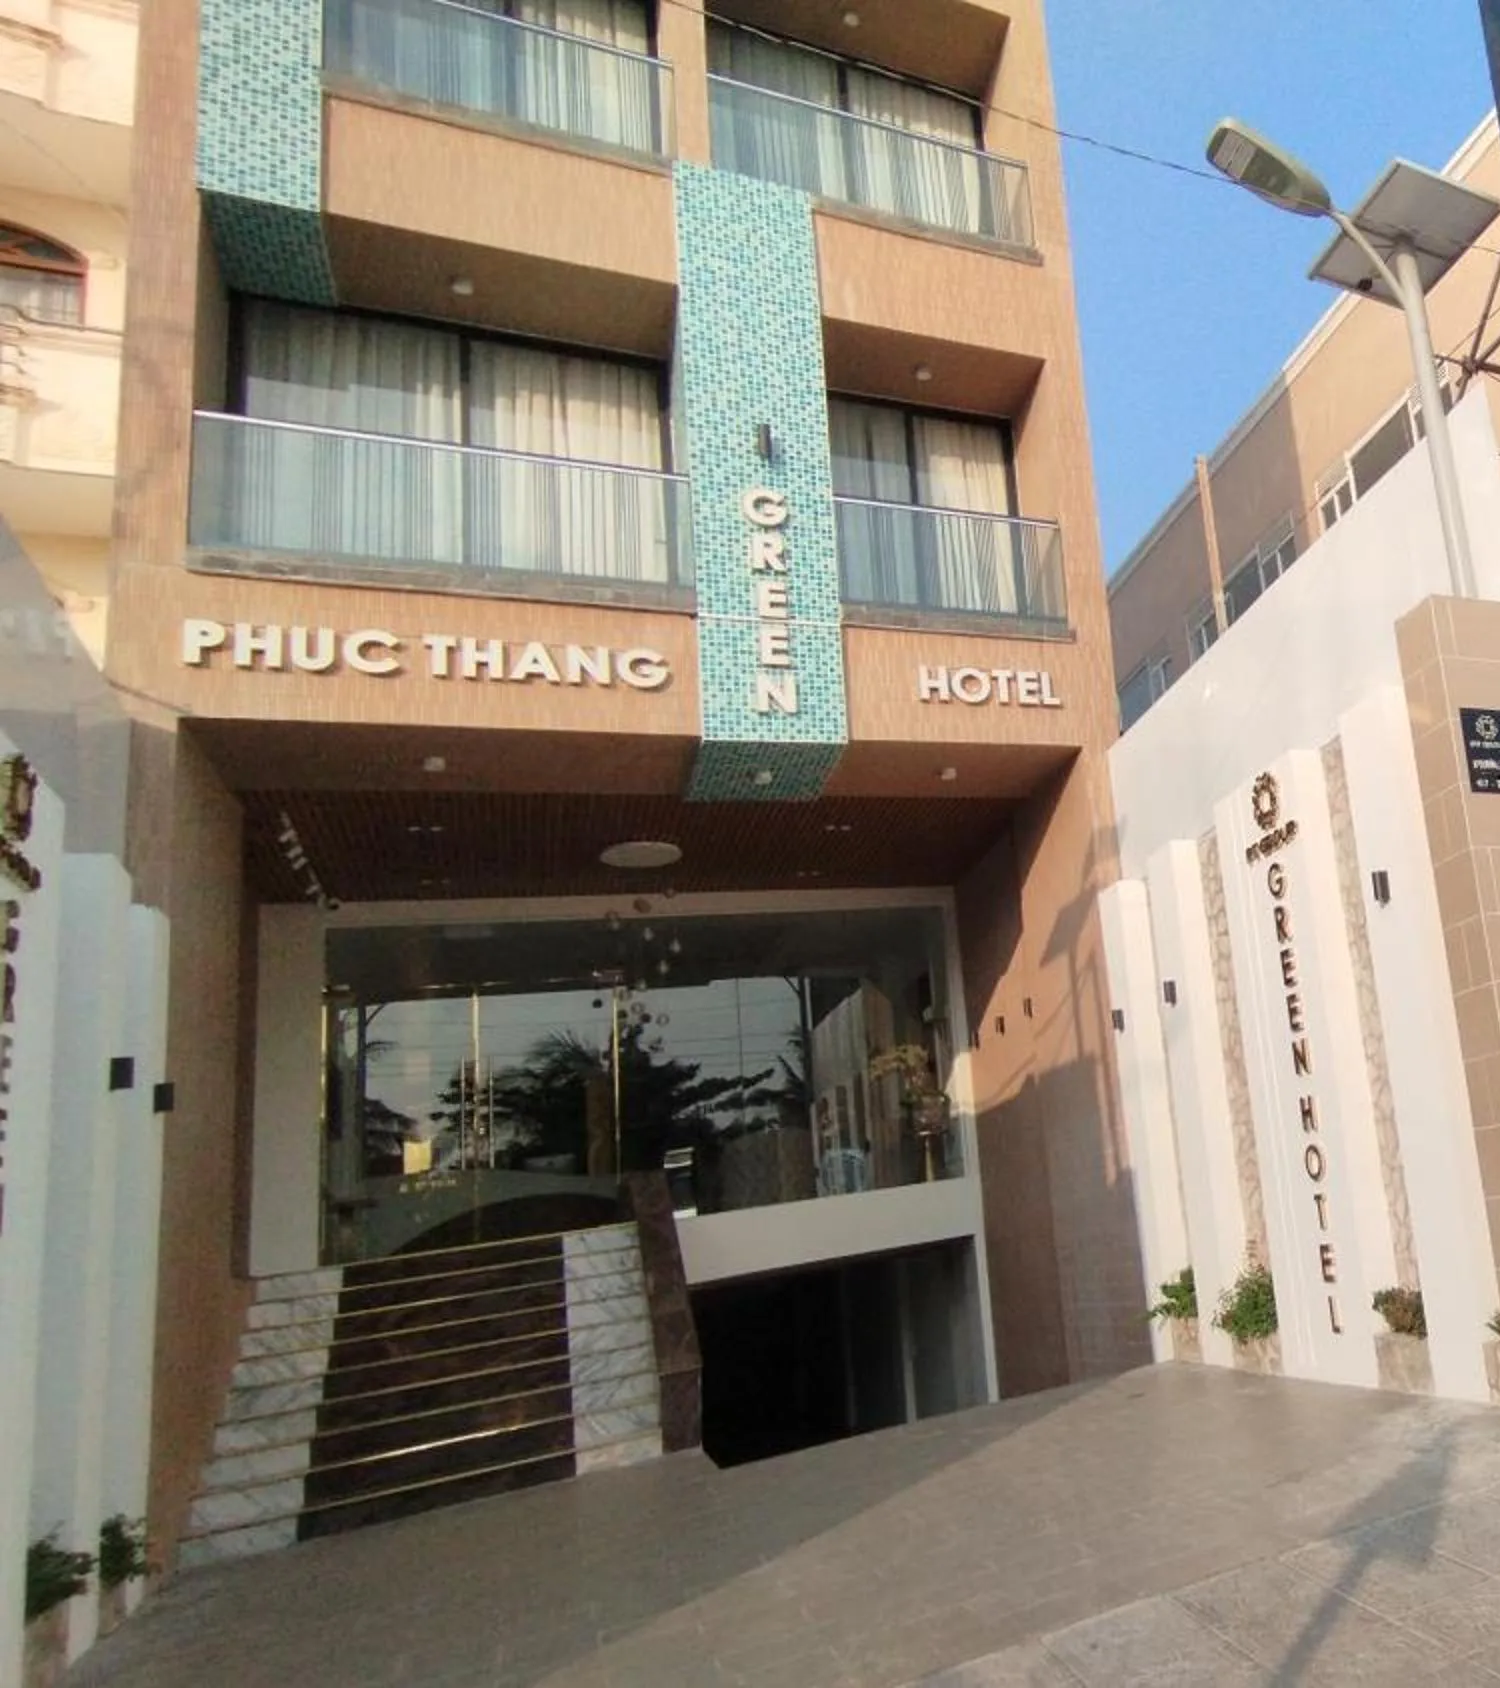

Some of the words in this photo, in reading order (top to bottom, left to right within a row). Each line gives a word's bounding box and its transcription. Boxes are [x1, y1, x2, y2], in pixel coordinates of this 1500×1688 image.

[181, 619, 403, 675] PHUC
[422, 634, 673, 690] THANG
[744, 487, 797, 714] GREEN
[918, 664, 1062, 706] HOTEL
[1267, 863, 1312, 1076] GREEN
[1300, 1095, 1343, 1334] HOTEL
